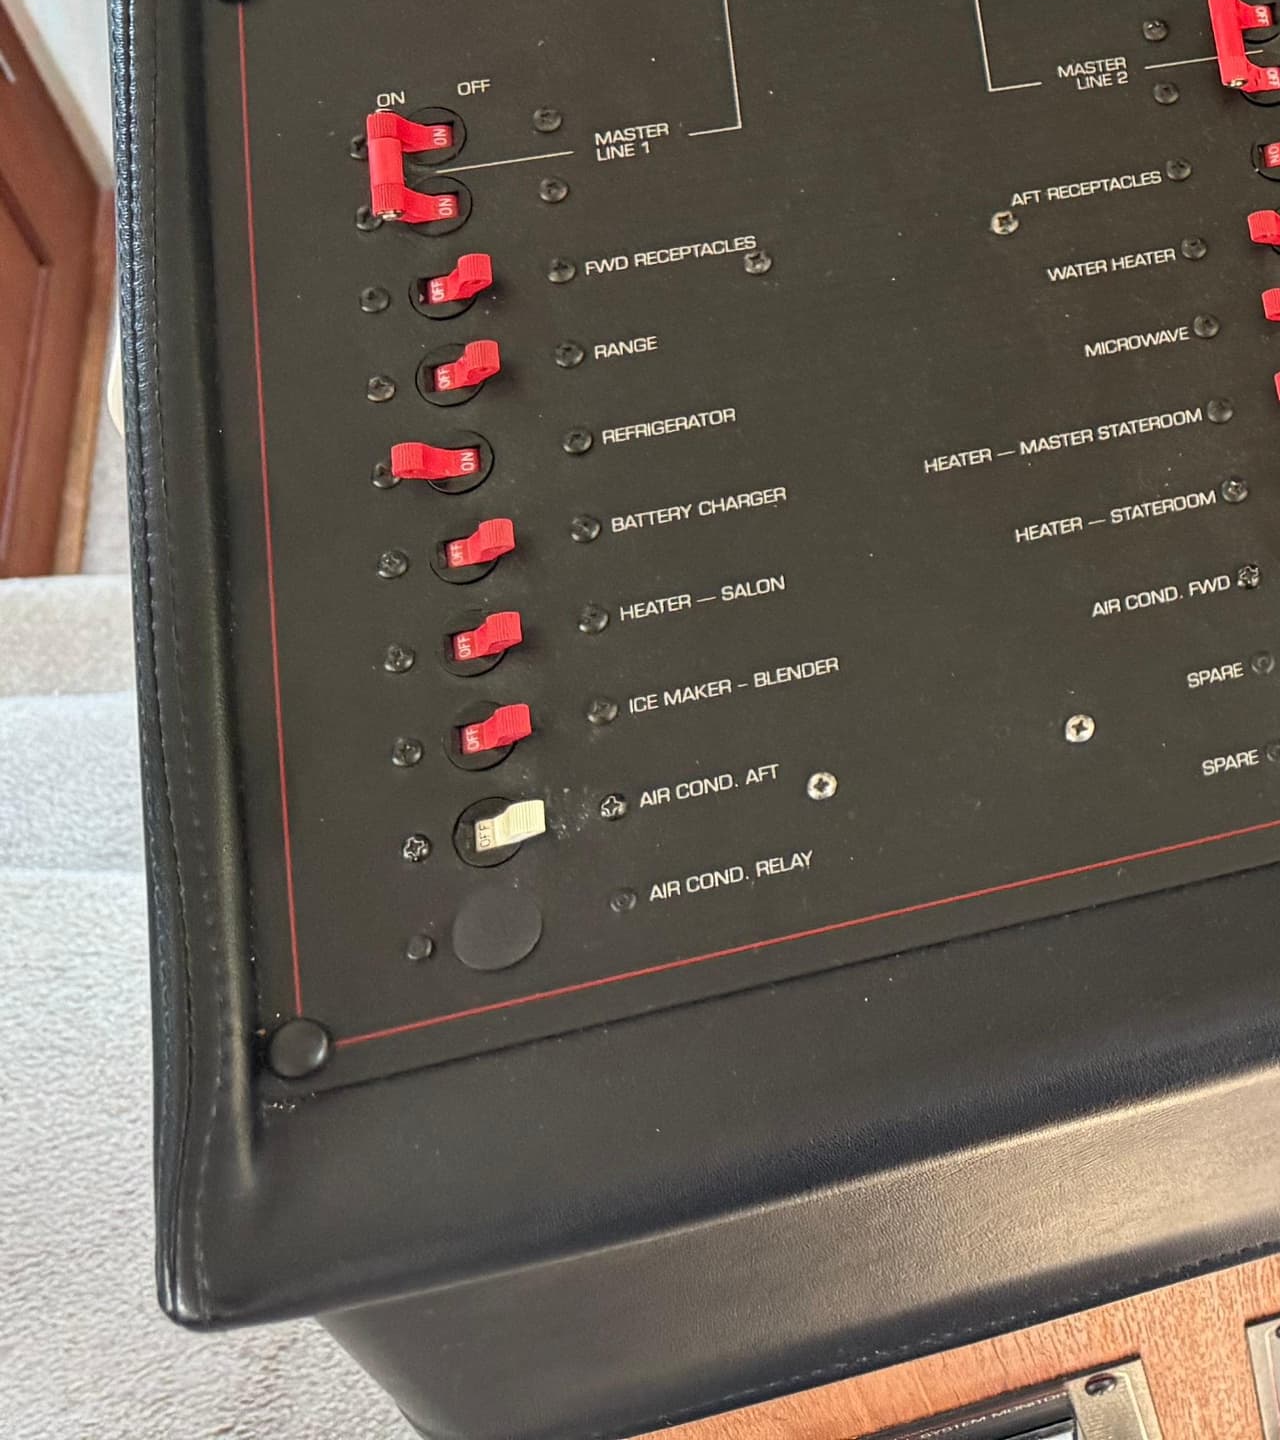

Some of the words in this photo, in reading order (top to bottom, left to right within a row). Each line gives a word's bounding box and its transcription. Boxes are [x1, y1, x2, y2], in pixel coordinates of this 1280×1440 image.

[1057, 57, 1127, 78] MASTER
[1076, 74, 1113, 90] LINE
[1117, 71, 1129, 84] 2
[377, 91, 406, 107] ON
[457, 79, 491, 96] OFF
[594, 122, 670, 146] MASTER
[596, 143, 635, 161] LINE
[641, 141, 650, 154] 1
[1011, 190, 1041, 208] AFT
[1047, 171, 1162, 201] RECEPTACLES
[585, 255, 629, 276] FWD
[634, 235, 757, 267] RECEPTACLES
[1047, 259, 1108, 282] WATER
[1111, 248, 1176, 272] HEATER
[594, 336, 658, 360] RANGE
[1084, 326, 1190, 359] MICROWAVE
[602, 408, 737, 445] REFRIGERATOR
[924, 448, 992, 474] HEATER
[1020, 429, 1094, 455] MASTER
[1098, 408, 1202, 441] STATEROOM
[611, 503, 692, 533] BATTERY
[698, 487, 787, 517] CHARGER
[1015, 517, 1083, 543] HEATER
[1111, 490, 1217, 524] STATEROOM
[619, 594, 692, 622] HEATER
[721, 575, 786, 602] SALON
[1092, 599, 1121, 618] AIR
[1125, 586, 1184, 611] COND.
[1189, 575, 1230, 597] FWD
[629, 695, 659, 715] ICE
[663, 679, 732, 708] MAKER
[754, 657, 839, 688] BLENDER
[1187, 662, 1244, 688] SPARE
[1202, 749, 1260, 776] SPARE
[640, 789, 671, 808] AIR
[676, 773, 739, 801] COND.
[745, 764, 780, 784] AFT
[649, 882, 680, 902] AIR
[686, 865, 749, 893] COND.
[756, 850, 814, 879] RELAY
